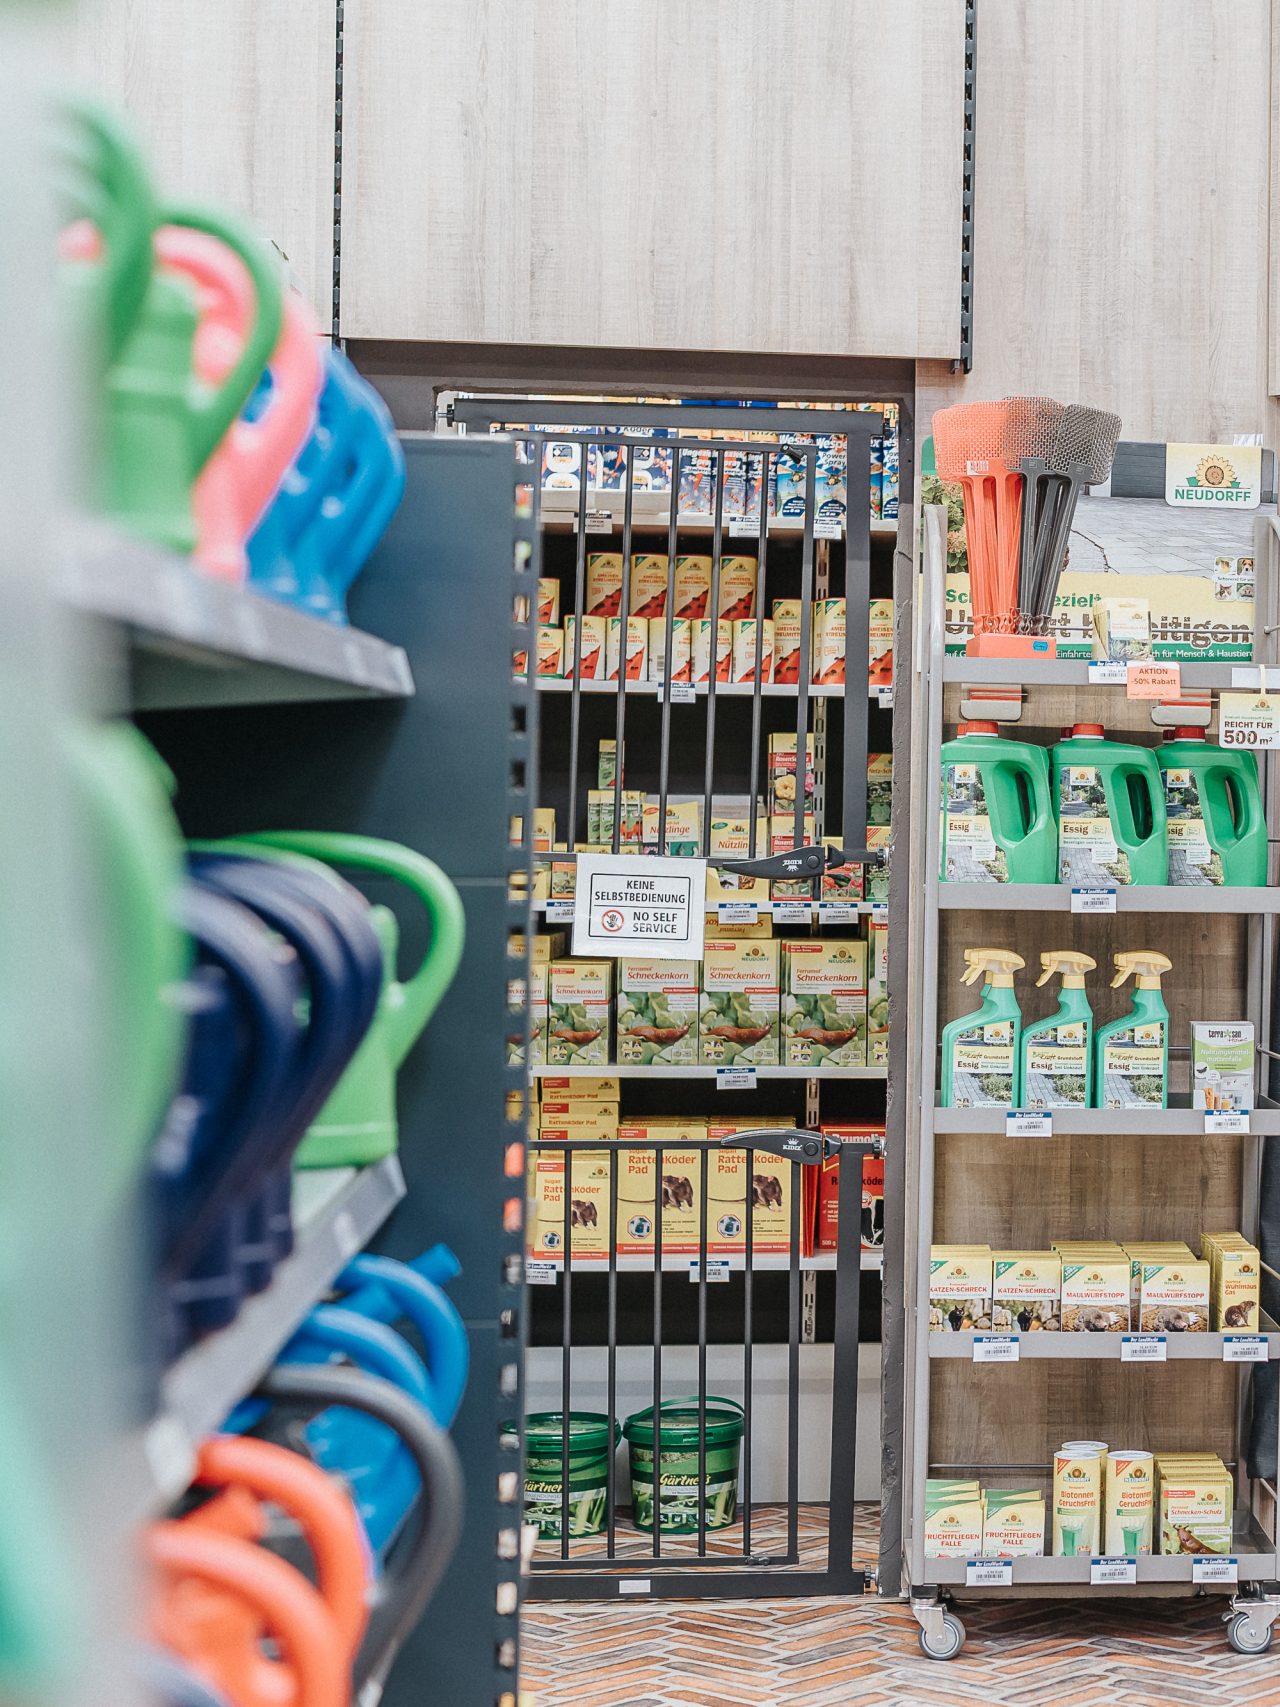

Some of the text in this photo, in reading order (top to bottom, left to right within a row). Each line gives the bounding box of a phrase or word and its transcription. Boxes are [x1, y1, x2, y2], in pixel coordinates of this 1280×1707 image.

[1175, 489, 1251, 502] NEUDORFF
[1056, 650, 1092, 658] Einfahrte
[1224, 730, 1257, 744] 500
[949, 822, 969, 832] Essig
[1064, 825, 1088, 835] Essig
[626, 880, 655, 890] KEINE
[595, 891, 685, 904] SELBSTBEDIENUNG
[633, 912, 677, 922] NO SELF
[633, 923, 677, 933] SERVICE
[710, 972, 771, 980] Schneckenkorn
[796, 974, 857, 982] Schneckenkorn
[958, 1061, 979, 1071] Essig
[1031, 1062, 1053, 1070] Essig
[1108, 1063, 1130, 1072] Essig
[628, 1166, 648, 1174] Pad
[718, 1165, 737, 1174] Pad
[544, 1194, 560, 1202] Pad
[1061, 1491, 1094, 1499] Biotonnen
[1122, 1491, 1152, 1499] Biotonnen
[1059, 1500, 1096, 1508] GeruchsFrei
